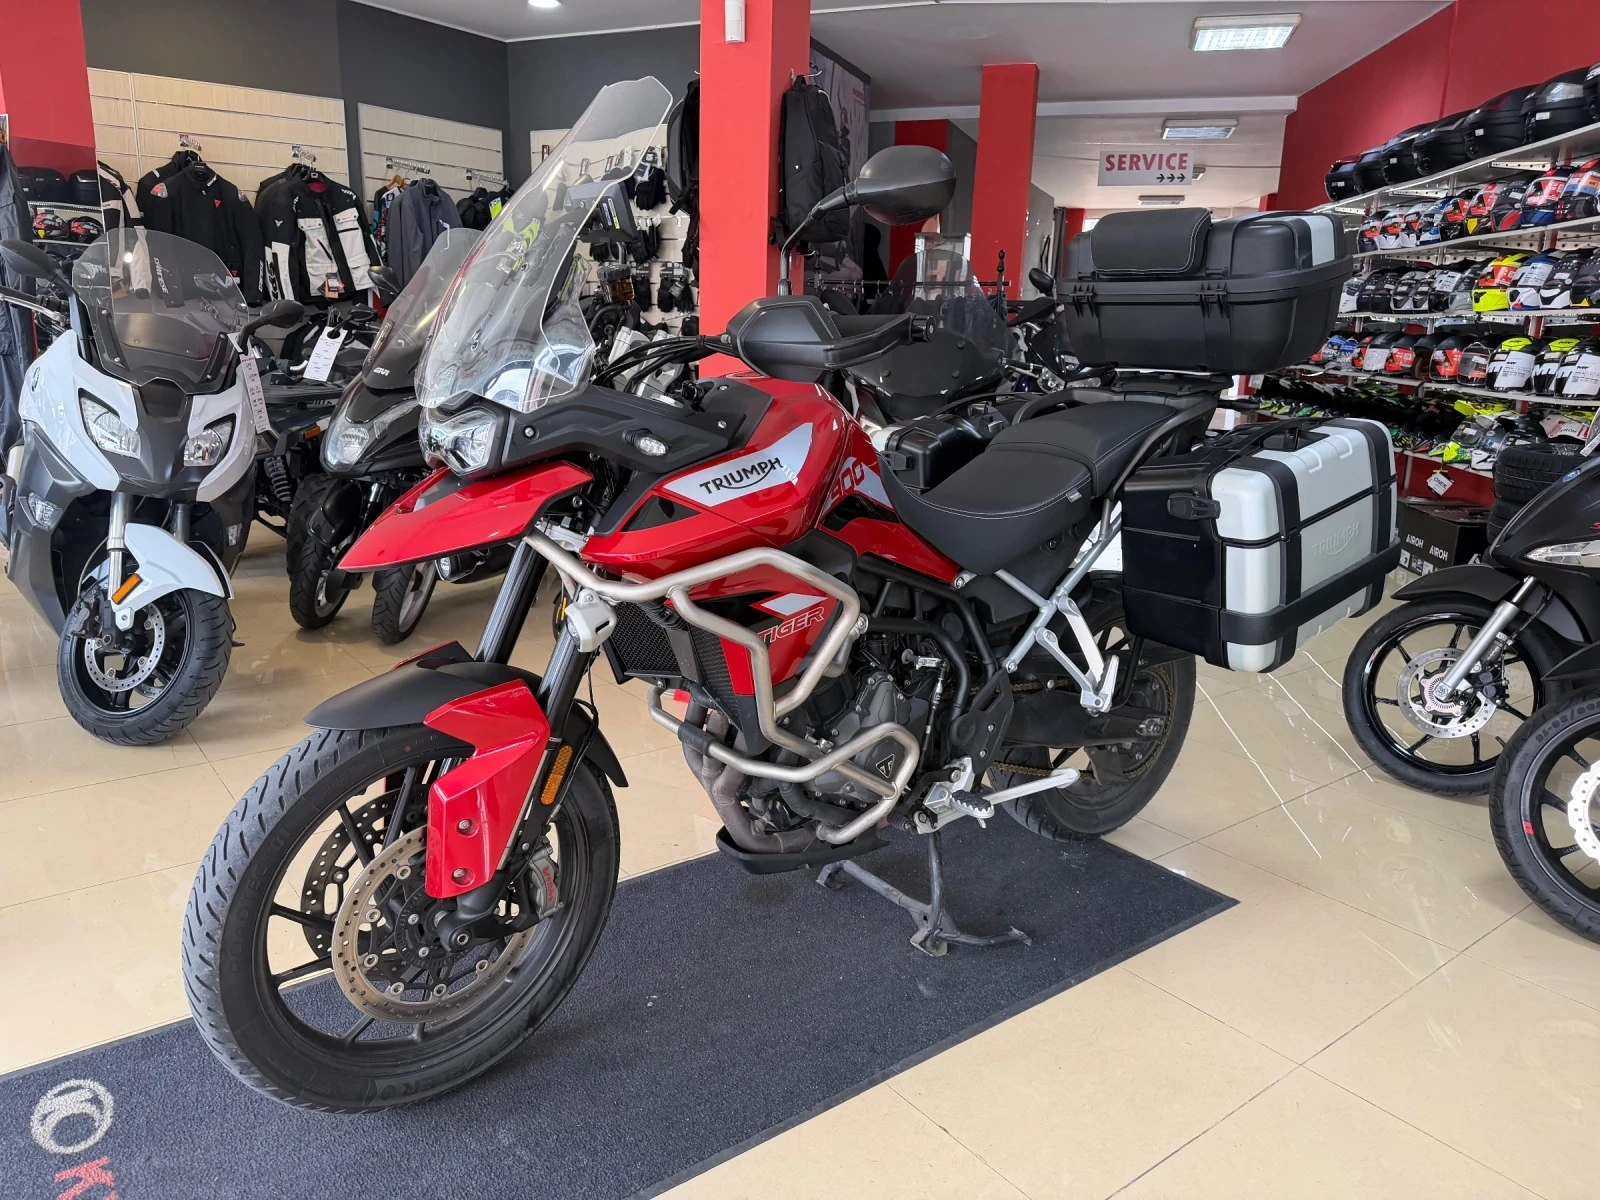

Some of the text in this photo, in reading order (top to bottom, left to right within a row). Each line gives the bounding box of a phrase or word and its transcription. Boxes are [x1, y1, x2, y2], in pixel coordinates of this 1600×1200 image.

[1105, 153, 1188, 171] SERVICE
[373, 366, 390, 377] GIVI
[699, 457, 784, 495] TRIUMPH
[1311, 521, 1360, 560] TRIUMPH
[1406, 533, 1424, 549] AIROH
[1429, 545, 1449, 561] AIROH
[757, 605, 825, 644] TIGER
